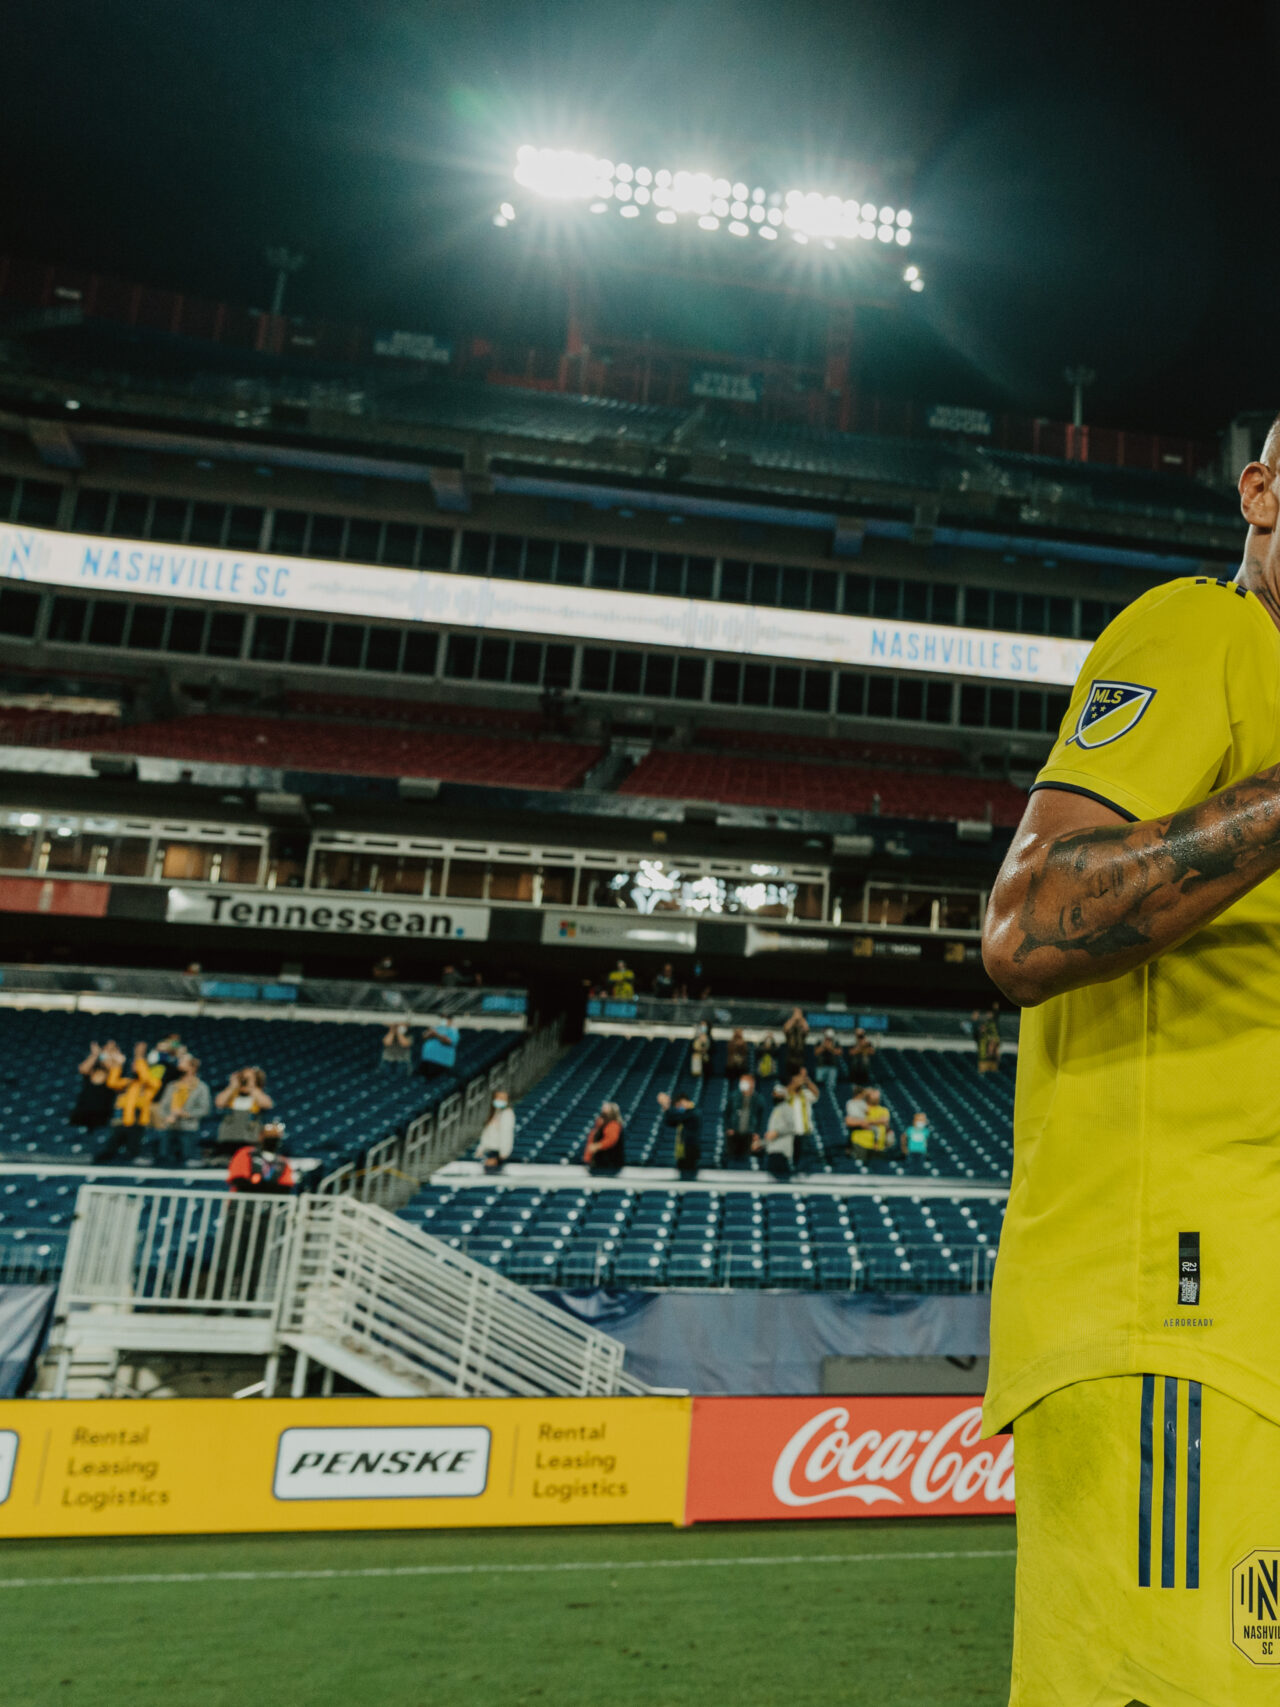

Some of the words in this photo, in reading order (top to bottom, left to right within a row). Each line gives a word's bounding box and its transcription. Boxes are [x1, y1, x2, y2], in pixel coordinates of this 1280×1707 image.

[81, 547, 244, 593] NASHVILLE
[253, 565, 290, 598] SC
[870, 628, 1000, 670] NASHVILLE
[1010, 644, 1039, 673] SC
[1093, 689, 1124, 704] MLS
[1163, 1318, 1214, 1327] AEROREADY
[72, 1426, 149, 1447] Rental
[538, 1423, 606, 1443] Rental
[67, 1456, 159, 1480] Leasing
[289, 1449, 477, 1476] PENSKE
[536, 1452, 616, 1474] Leasing
[772, 1407, 1016, 1506] Coca-Col
[61, 1486, 171, 1511] Logistics
[533, 1480, 628, 1503] Logistics
[1262, 1641, 1273, 1655] SC
